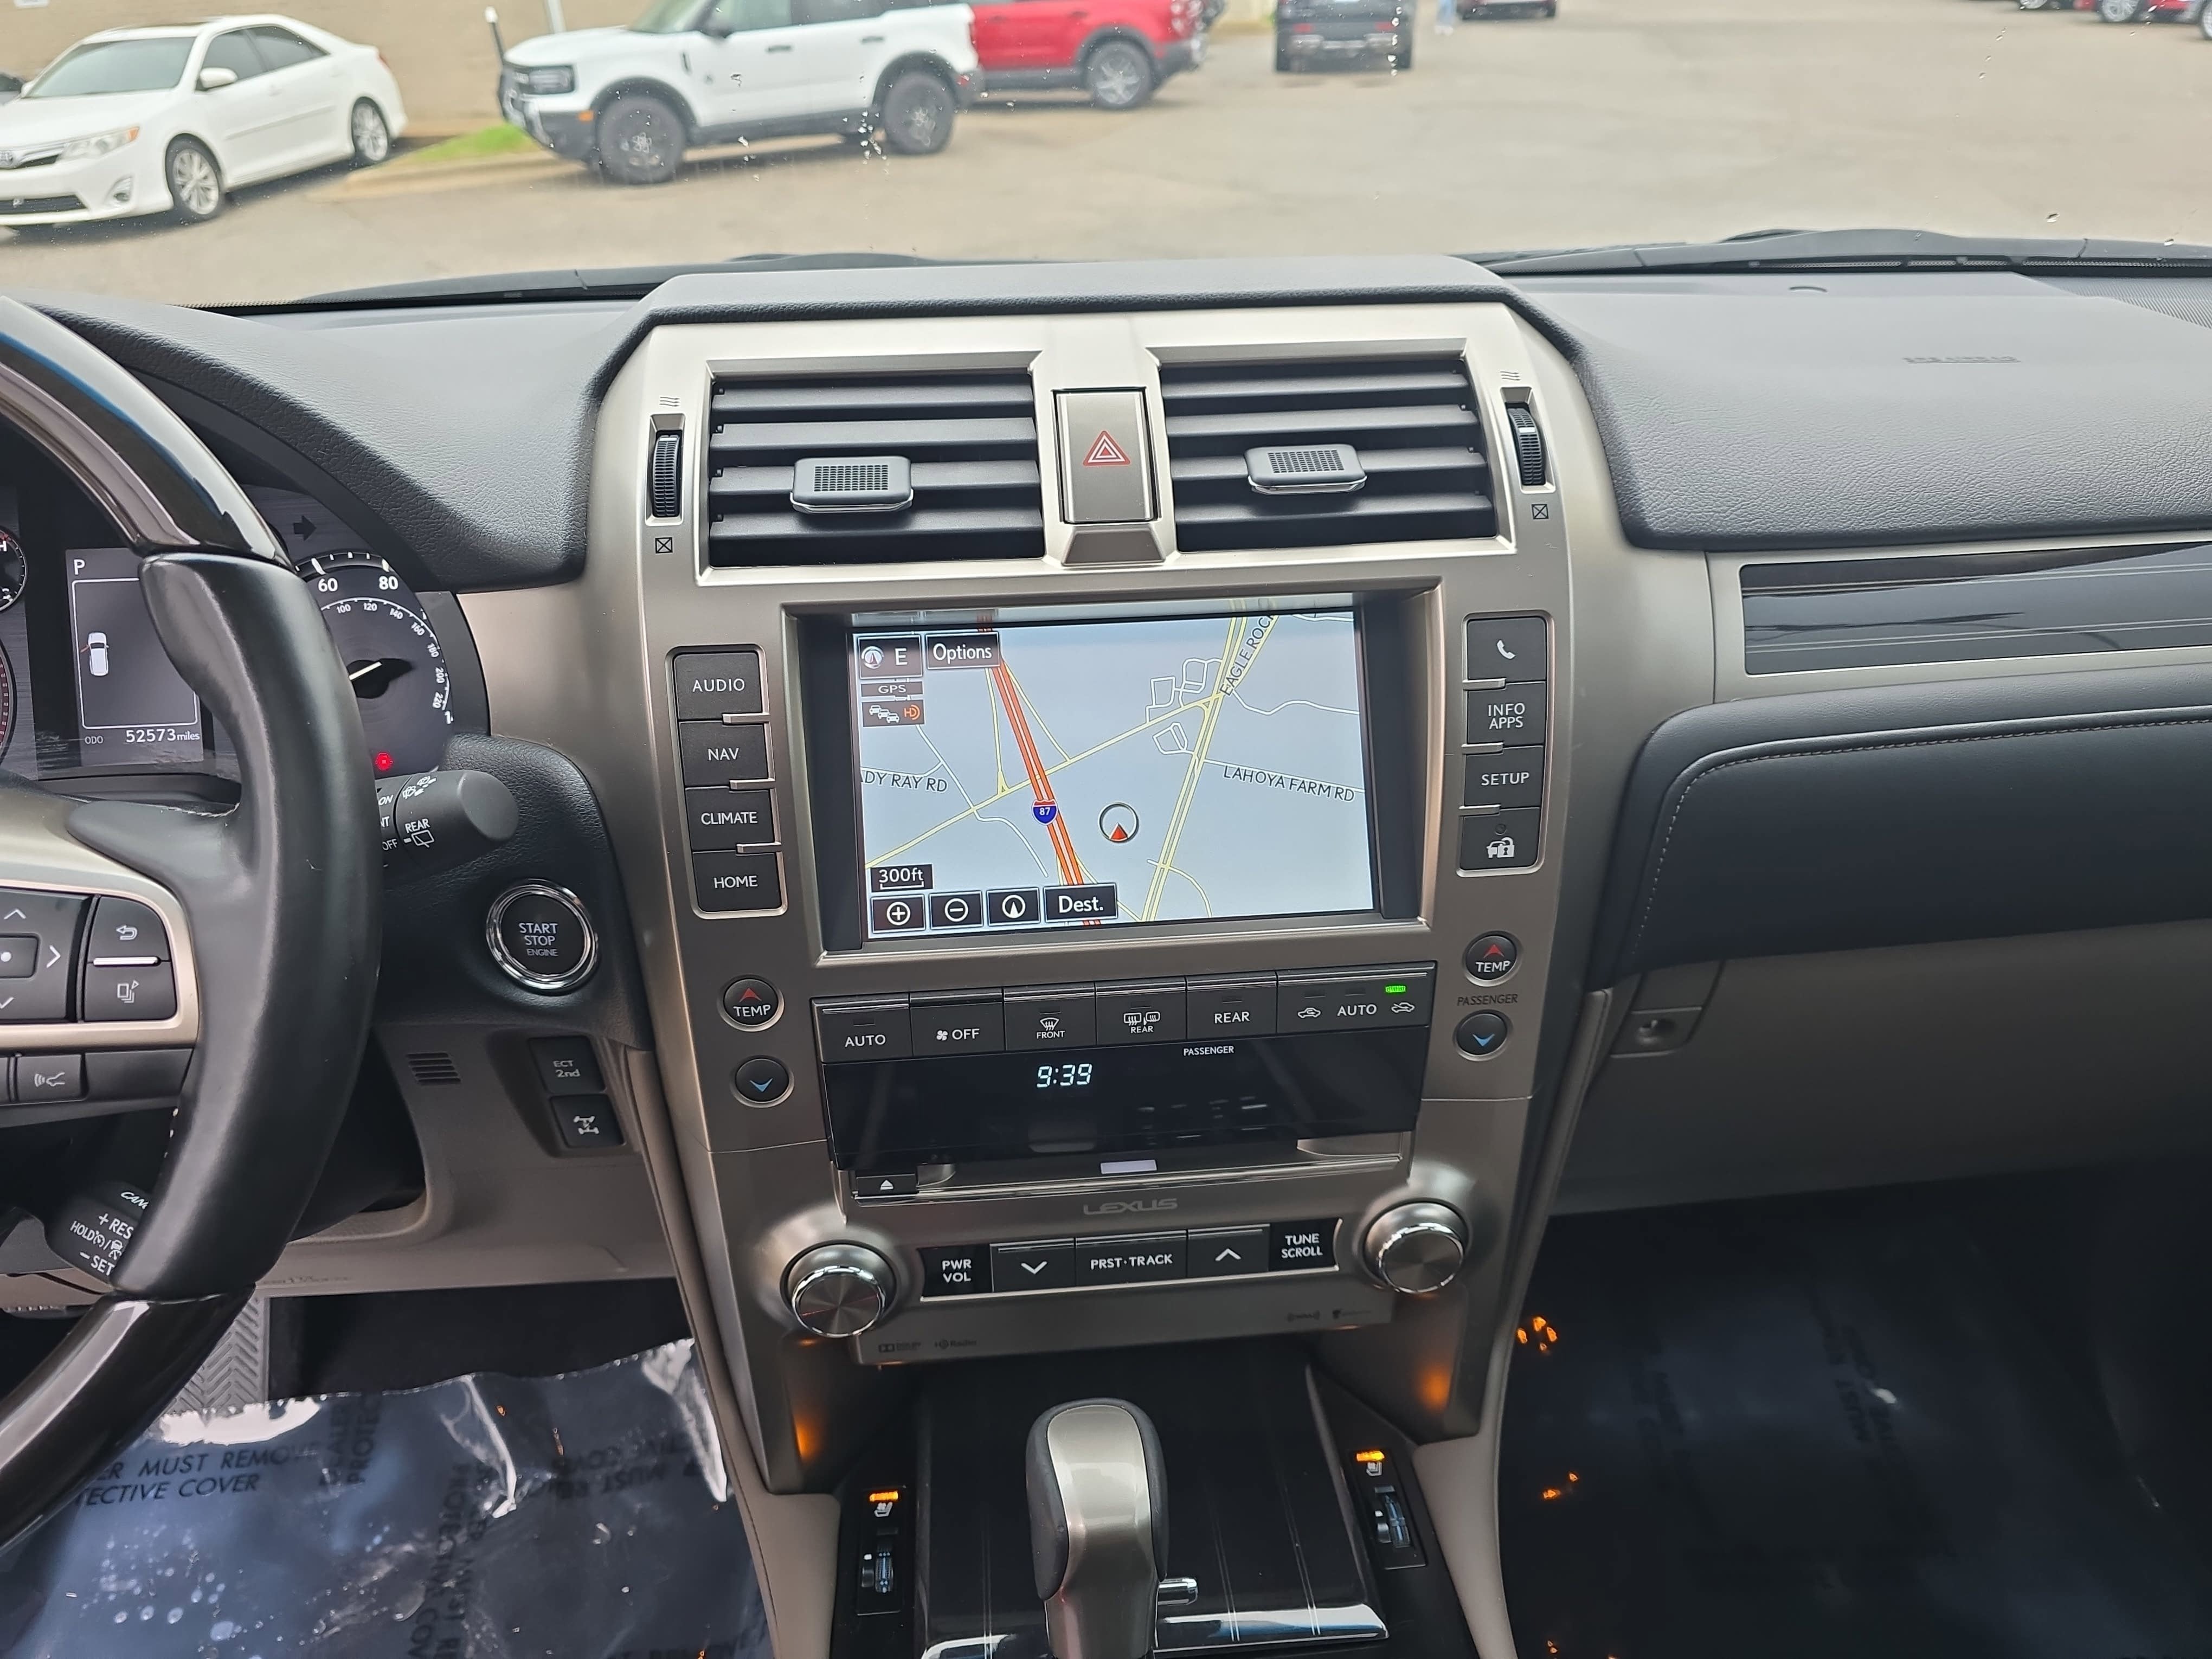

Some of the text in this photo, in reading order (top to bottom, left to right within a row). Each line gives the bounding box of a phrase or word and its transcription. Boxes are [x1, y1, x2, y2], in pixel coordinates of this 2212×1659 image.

[74, 559, 85, 575] P
[318, 578, 338, 592] 60
[379, 576, 398, 590] 80
[336, 603, 445, 709] 100 120 140 160 180 200 220
[895, 648, 908, 665] E
[933, 643, 992, 664] Options
[1220, 648, 1253, 696] EAGLE
[692, 678, 745, 692] AUDIO
[878, 684, 906, 693] GPS
[1488, 703, 1525, 717] INFO
[1489, 716, 1523, 729] APPS
[85, 736, 104, 744] ODO
[126, 729, 200, 743] 52573 miles
[708, 748, 740, 761] NAV
[861, 771, 948, 792] DY RAY RD
[1223, 765, 1354, 802] LAHOYA FARM RD
[1481, 772, 1529, 786] SETUP
[1039, 807, 1051, 816] 87
[380, 816, 390, 828] NT
[701, 812, 758, 825] CLIMATE
[405, 818, 430, 833] REAR
[382, 839, 397, 851] OFF
[879, 867, 923, 883] 300ft
[713, 876, 758, 889] HOME
[1058, 895, 1104, 914] Dest.
[518, 923, 558, 934] START
[524, 935, 555, 946] STOP
[1475, 960, 1511, 973] TEMP
[1457, 994, 1518, 1006] PASSENGER
[733, 1004, 771, 1018] TEMP
[1337, 1004, 1378, 1017] AUTO
[1214, 1011, 1250, 1024] REAR
[951, 1028, 980, 1040] OFF
[1036, 1030, 1066, 1039] FRONT
[1130, 1025, 1154, 1034] REAR
[845, 1034, 886, 1047] AUTO
[1183, 1045, 1235, 1057] PASSENGER
[557, 1069, 581, 1078] 2nd
[1036, 1063, 1093, 1088] 9:39
[1084, 1198, 1178, 1215] LEXUS
[70, 1220, 94, 1242] HOLD
[1285, 1233, 1320, 1246] TUNE
[1281, 1246, 1323, 1259] SCROLL
[942, 1259, 972, 1271] PWR
[942, 1272, 972, 1283] VOL
[138, 1454, 209, 1477] MUST
[75, 1473, 260, 1507] TECTIVE COVER
